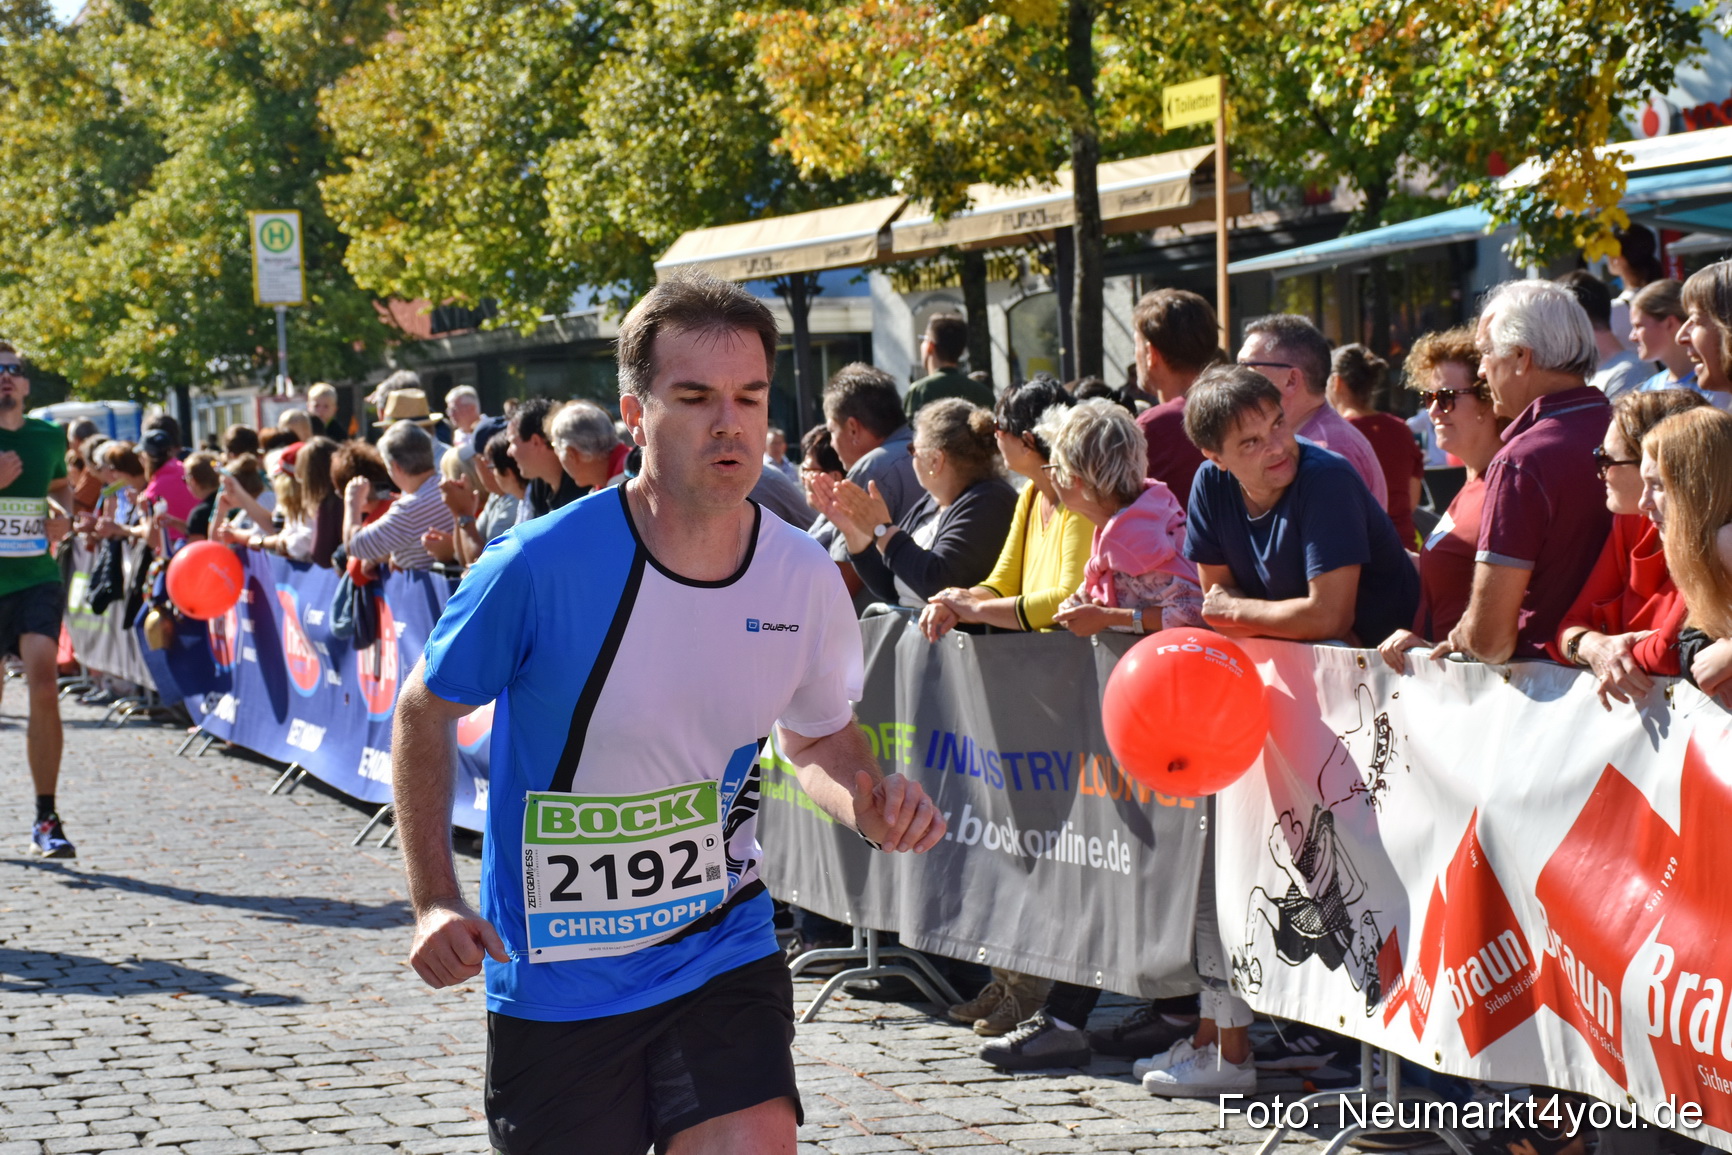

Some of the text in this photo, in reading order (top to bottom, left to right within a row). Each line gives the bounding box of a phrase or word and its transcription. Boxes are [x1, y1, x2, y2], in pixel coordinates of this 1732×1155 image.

[269, 227, 285, 244] H
[1156, 636, 1245, 675] RÖDL
[540, 788, 706, 839] BOCK
[705, 837, 715, 848] D
[547, 840, 703, 902] 2192
[1644, 856, 1679, 913] Seit 1929
[548, 899, 707, 938] CHRISTOPH
[1484, 990, 1513, 1015] Sicher
[1510, 981, 1525, 998] ist
